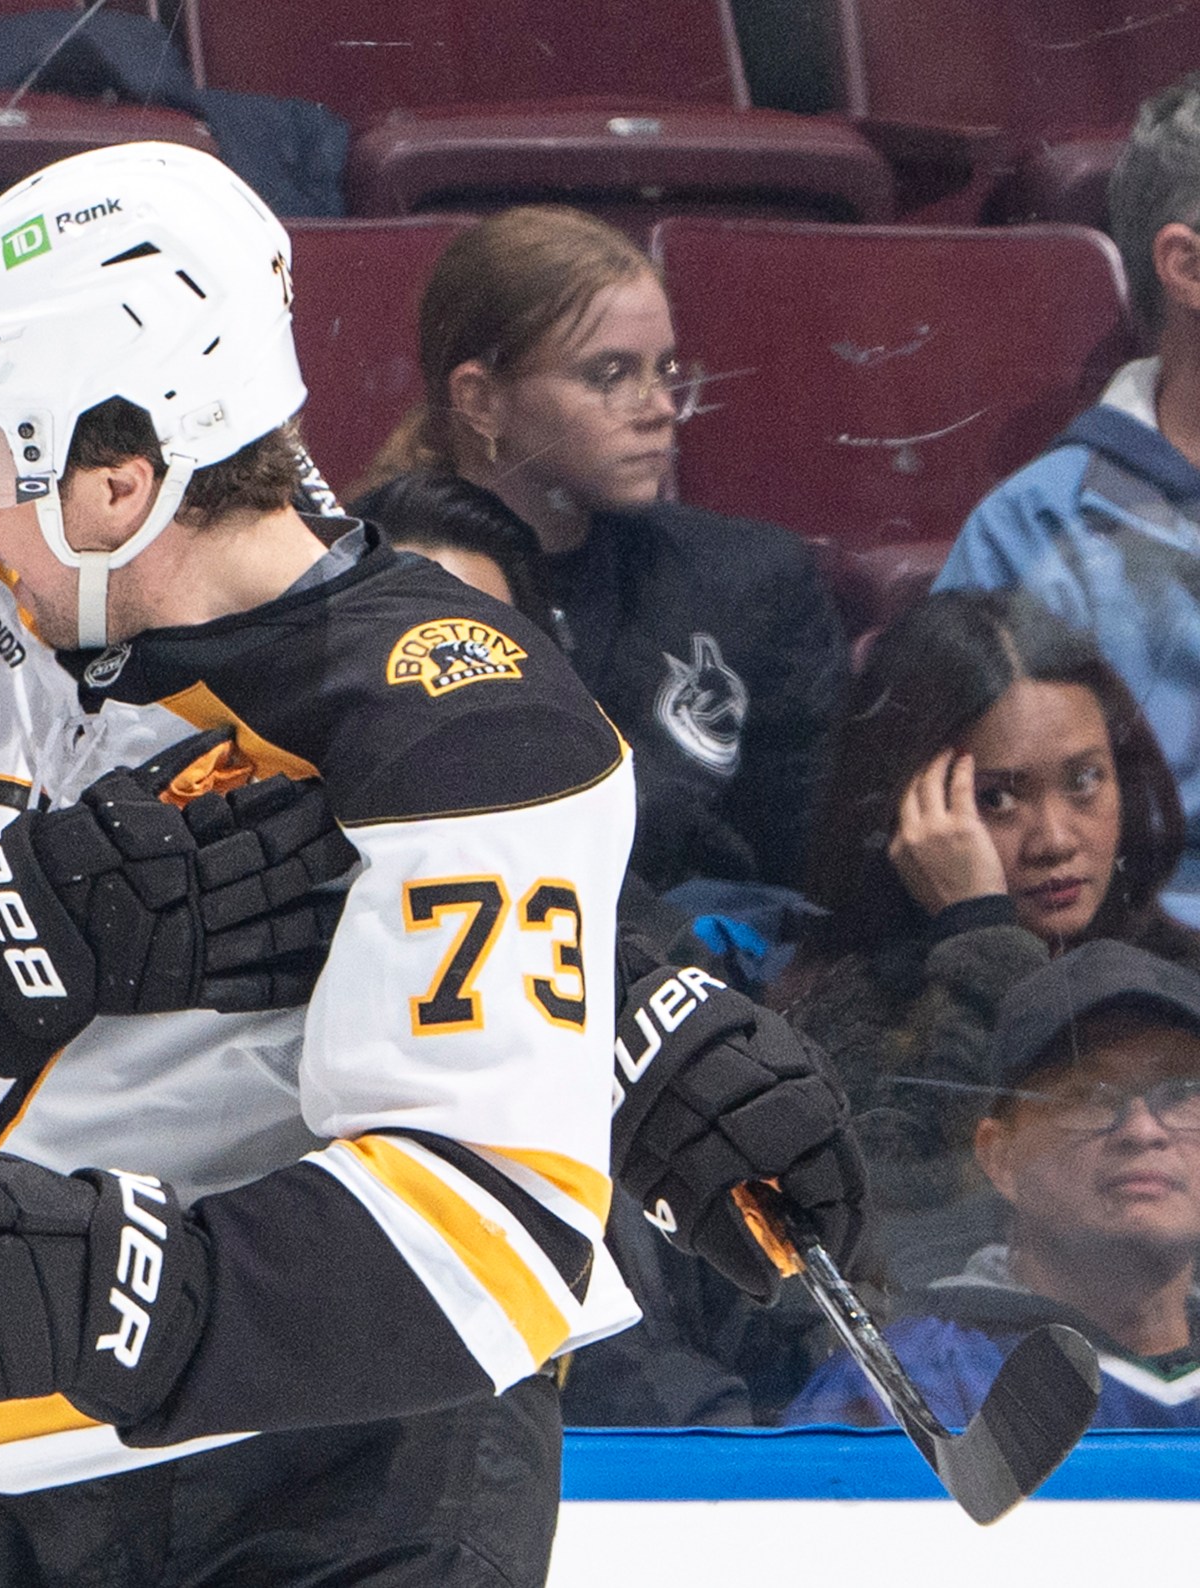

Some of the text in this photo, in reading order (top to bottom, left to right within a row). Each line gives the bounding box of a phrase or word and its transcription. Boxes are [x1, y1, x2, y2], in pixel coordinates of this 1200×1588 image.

[3, 223, 45, 259] TD
[395, 623, 520, 678] BOSTON
[402, 874, 587, 1036] 73
[95, 1168, 167, 1368] UER
